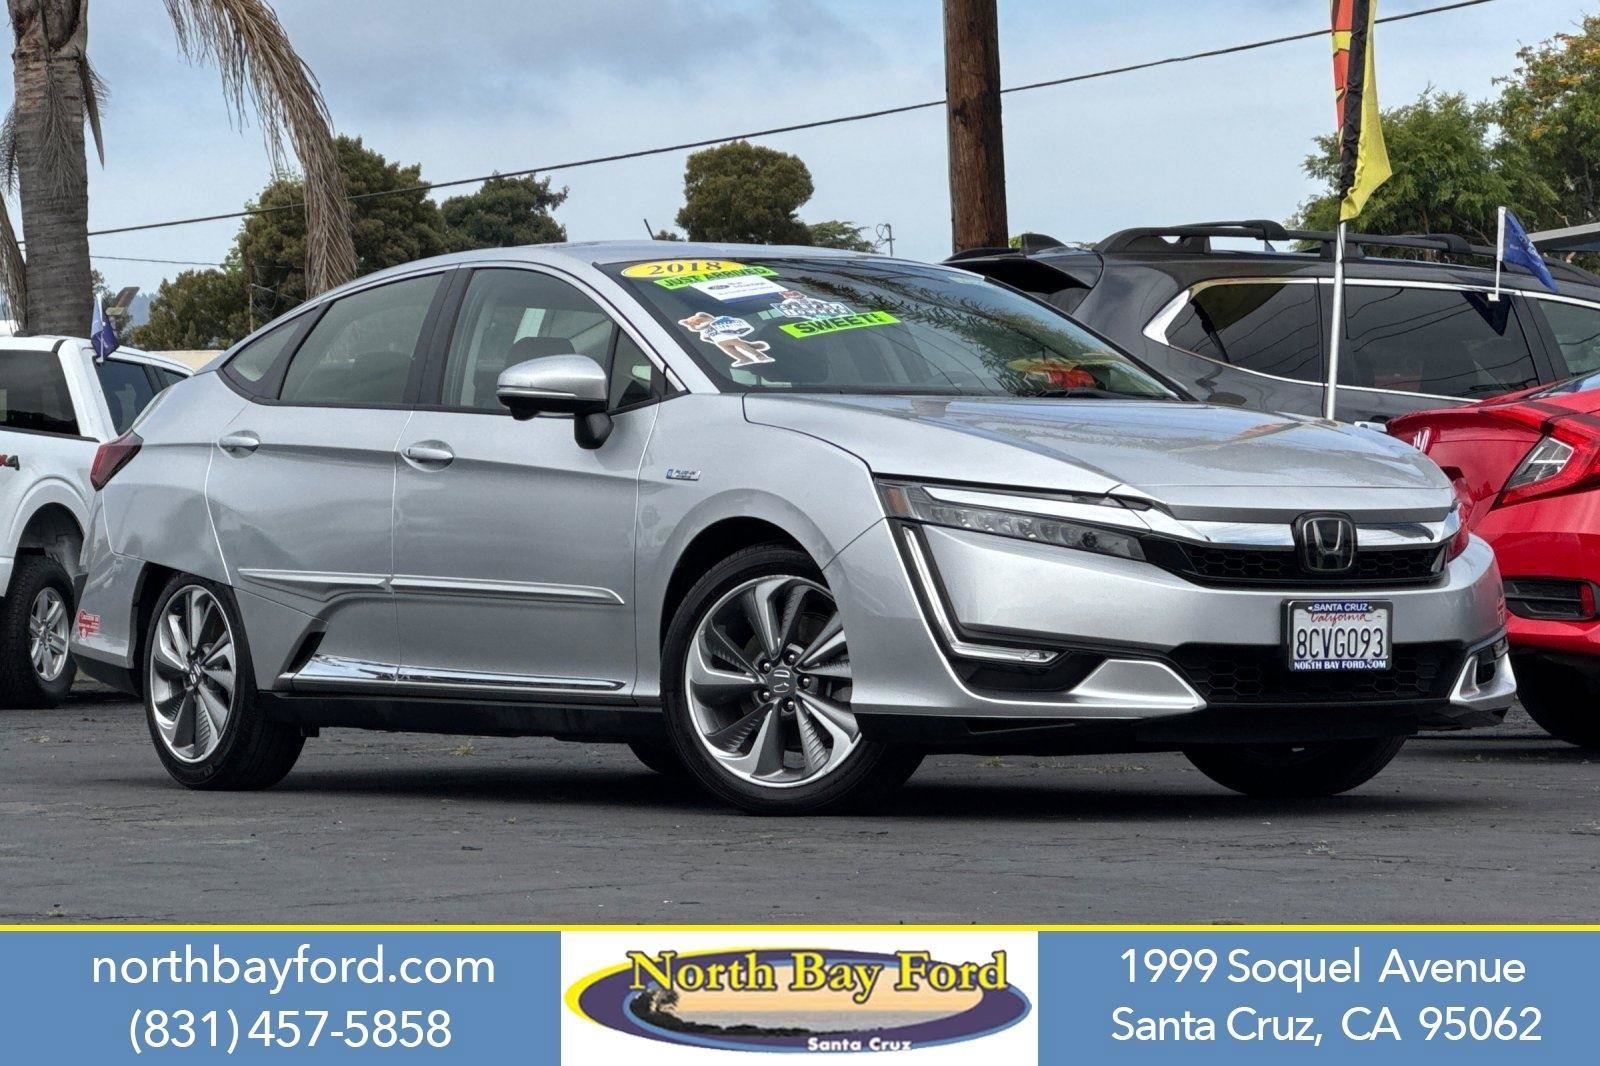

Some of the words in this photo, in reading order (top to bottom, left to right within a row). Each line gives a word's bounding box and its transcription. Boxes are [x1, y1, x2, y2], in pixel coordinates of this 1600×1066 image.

[648, 261, 722, 275] 2018
[664, 276, 699, 287] JUST
[794, 313, 886, 334] SWEET!
[1314, 603, 1341, 611] SANTA
[1344, 603, 1368, 611] CRUZ
[1308, 612, 1372, 626] California
[1297, 628, 1383, 658] 8CVG093
[1294, 661, 1322, 669] NORTH
[1324, 661, 1340, 669] BAY
[1342, 660, 1386, 669] FORD.COM
